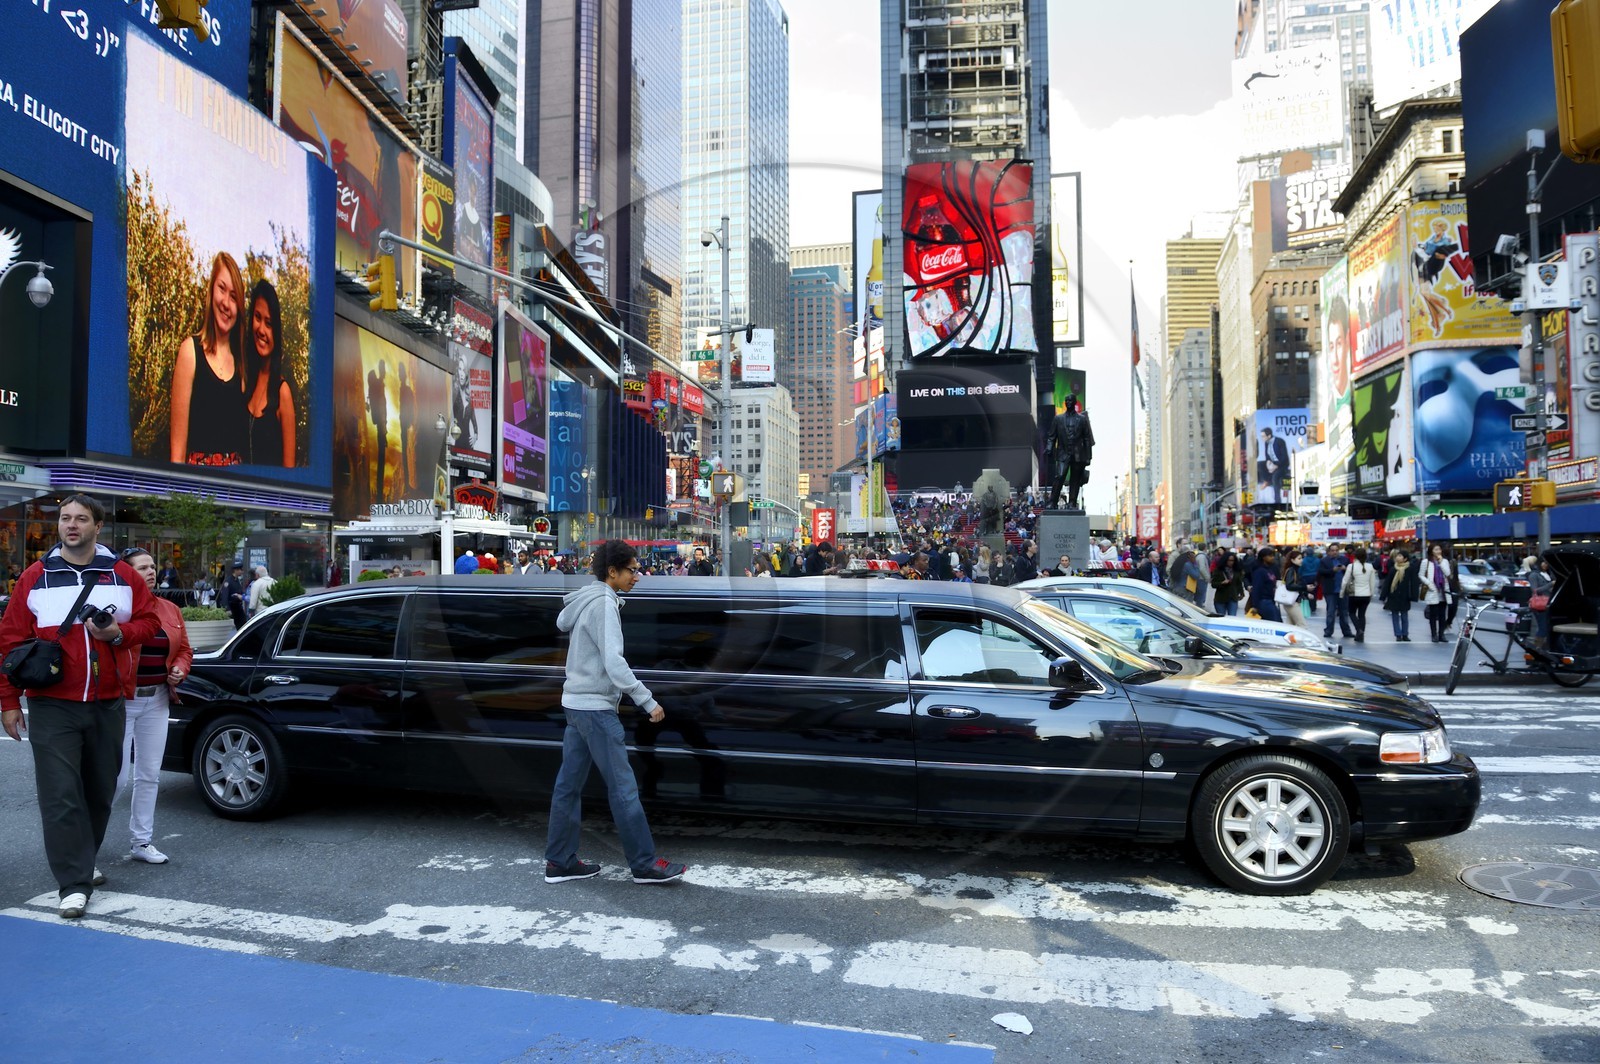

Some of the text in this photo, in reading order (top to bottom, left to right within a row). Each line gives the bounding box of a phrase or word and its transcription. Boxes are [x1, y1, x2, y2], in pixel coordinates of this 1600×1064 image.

[1285, 98, 1331, 118] BEST
[24, 93, 88, 147] ELLICOTT
[91, 134, 119, 165] CITY
[203, 79, 287, 176] FAMOUS!
[422, 192, 443, 241] Q
[922, 246, 962, 271] Coca-Cola
[1353, 253, 1374, 276] GOES
[698, 351, 706, 360] 46
[748, 353, 759, 361] did
[910, 384, 1020, 398] LIVE ON THIS BIG SCREEN
[1496, 388, 1504, 397] W
[1505, 388, 1516, 398] 46
[1275, 414, 1308, 426] men
[1284, 426, 1308, 436] wo
[1477, 469, 1493, 478] OF
[370, 499, 432, 516] snackBOX
[818, 511, 832, 539] tkts
[1142, 508, 1159, 538] tkts
[1250, 627, 1274, 636] POLICE
